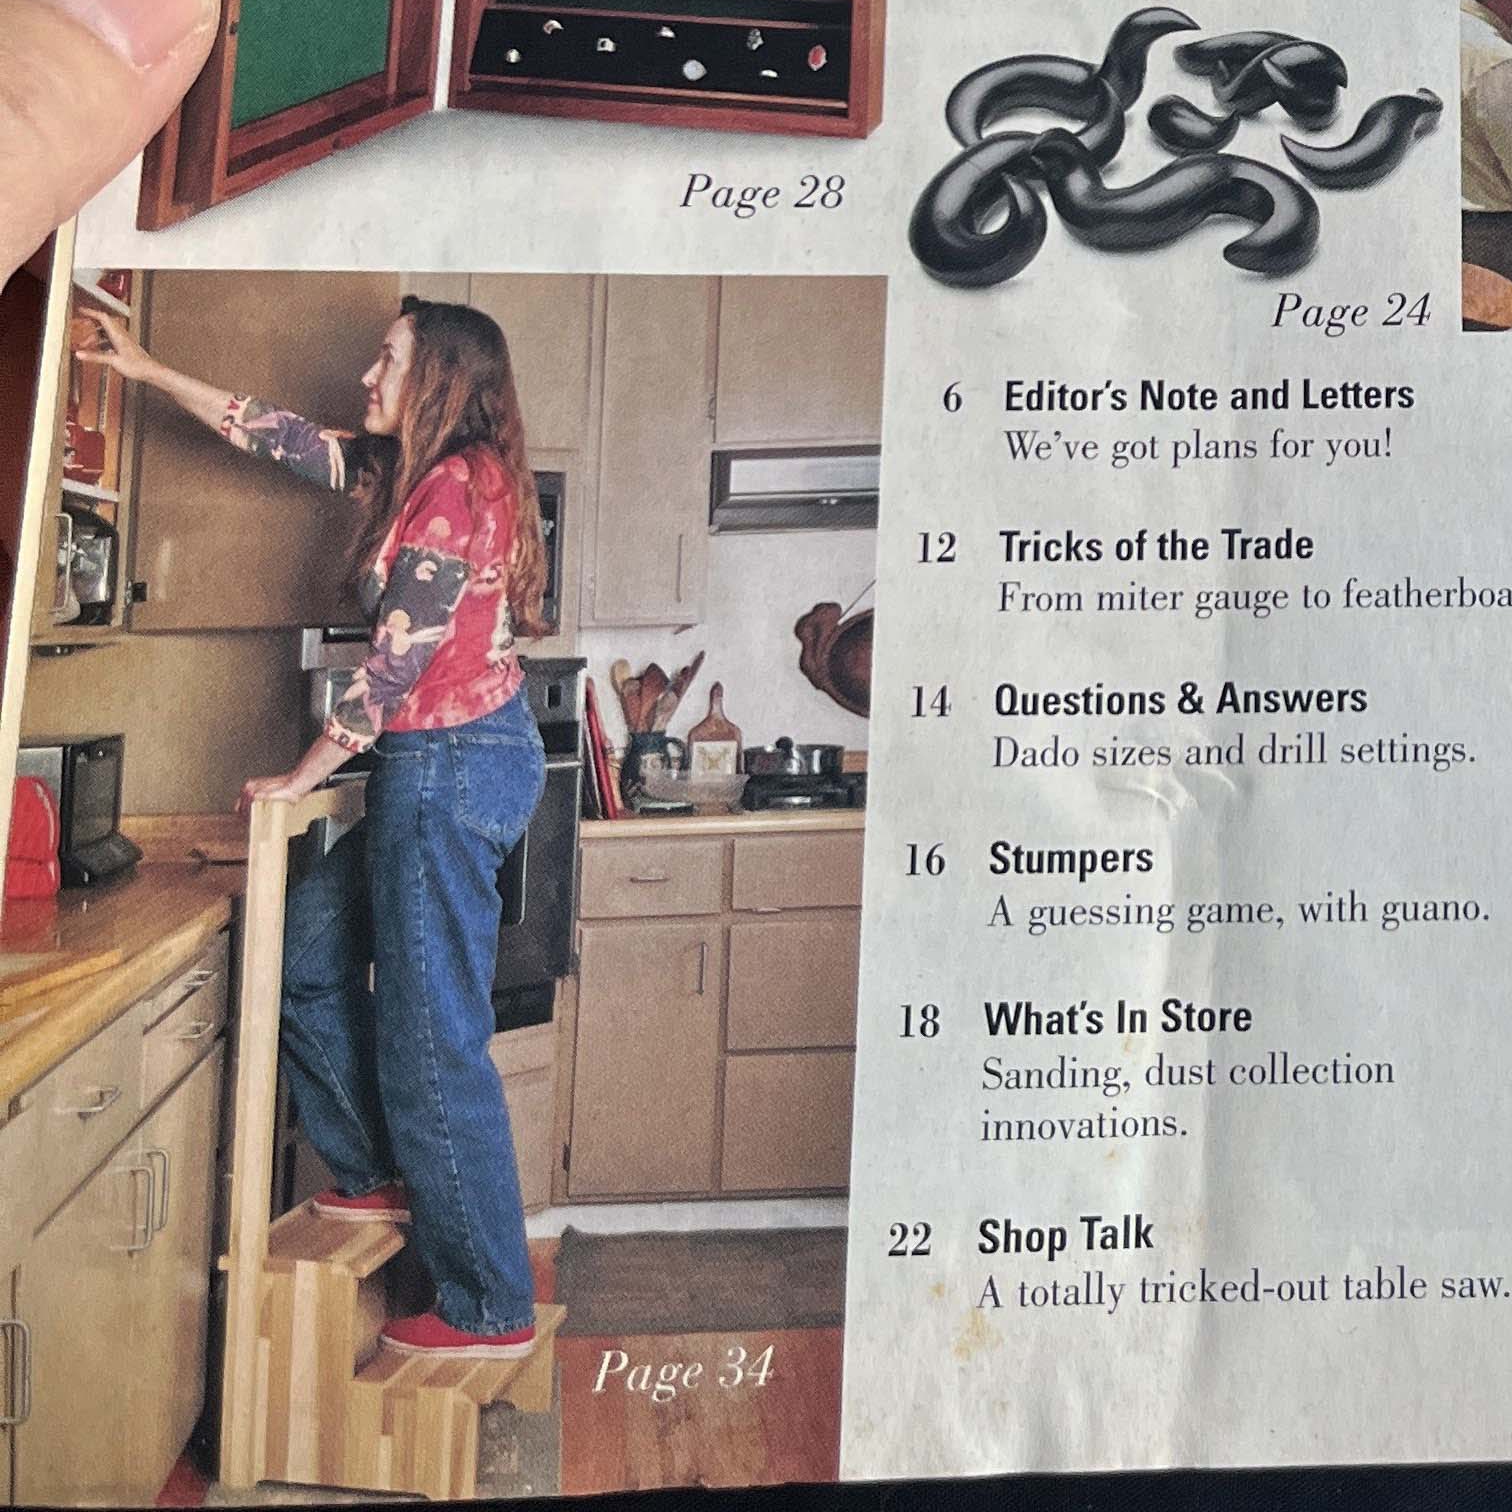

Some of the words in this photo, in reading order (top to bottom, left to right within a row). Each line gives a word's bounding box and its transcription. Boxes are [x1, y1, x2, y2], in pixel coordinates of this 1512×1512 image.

[679, 173, 781, 220] Page
[793, 174, 846, 209] 28
[1271, 292, 1369, 339] Page
[1381, 291, 1432, 327] 24
[942, 381, 963, 413] 6
[1005, 379, 1128, 412] Editor's
[1140, 379, 1218, 411] Note
[1230, 378, 1290, 411] and
[1302, 378, 1415, 410] Letters
[918, 531, 957, 564] 12
[998, 529, 1104, 563] Tricks
[1115, 528, 1148, 562] of
[1156, 528, 1210, 561] the
[1220, 527, 1314, 561] Trade
[911, 684, 952, 718] 14
[995, 682, 1166, 717] Questions
[1177, 680, 1205, 715] &
[1215, 681, 1368, 714] Answers
[905, 843, 946, 877] 16
[989, 840, 1154, 884] Stumpers
[986, 894, 1015, 927] A
[1028, 893, 1176, 937] guessing
[1186, 903, 1285, 934] game,
[1297, 888, 1369, 924] with
[1381, 900, 1489, 932] guano.
[899, 1003, 940, 1039] 18
[983, 1000, 1104, 1037] What's
[1117, 999, 1148, 1034] In
[1161, 998, 1252, 1033] Store
[887, 1221, 932, 1257] 22
[977, 1218, 1068, 1262] Shop
[1079, 1213, 1154, 1251] Talk
[591, 1349, 704, 1403] Page
[718, 1343, 776, 1389] 34
